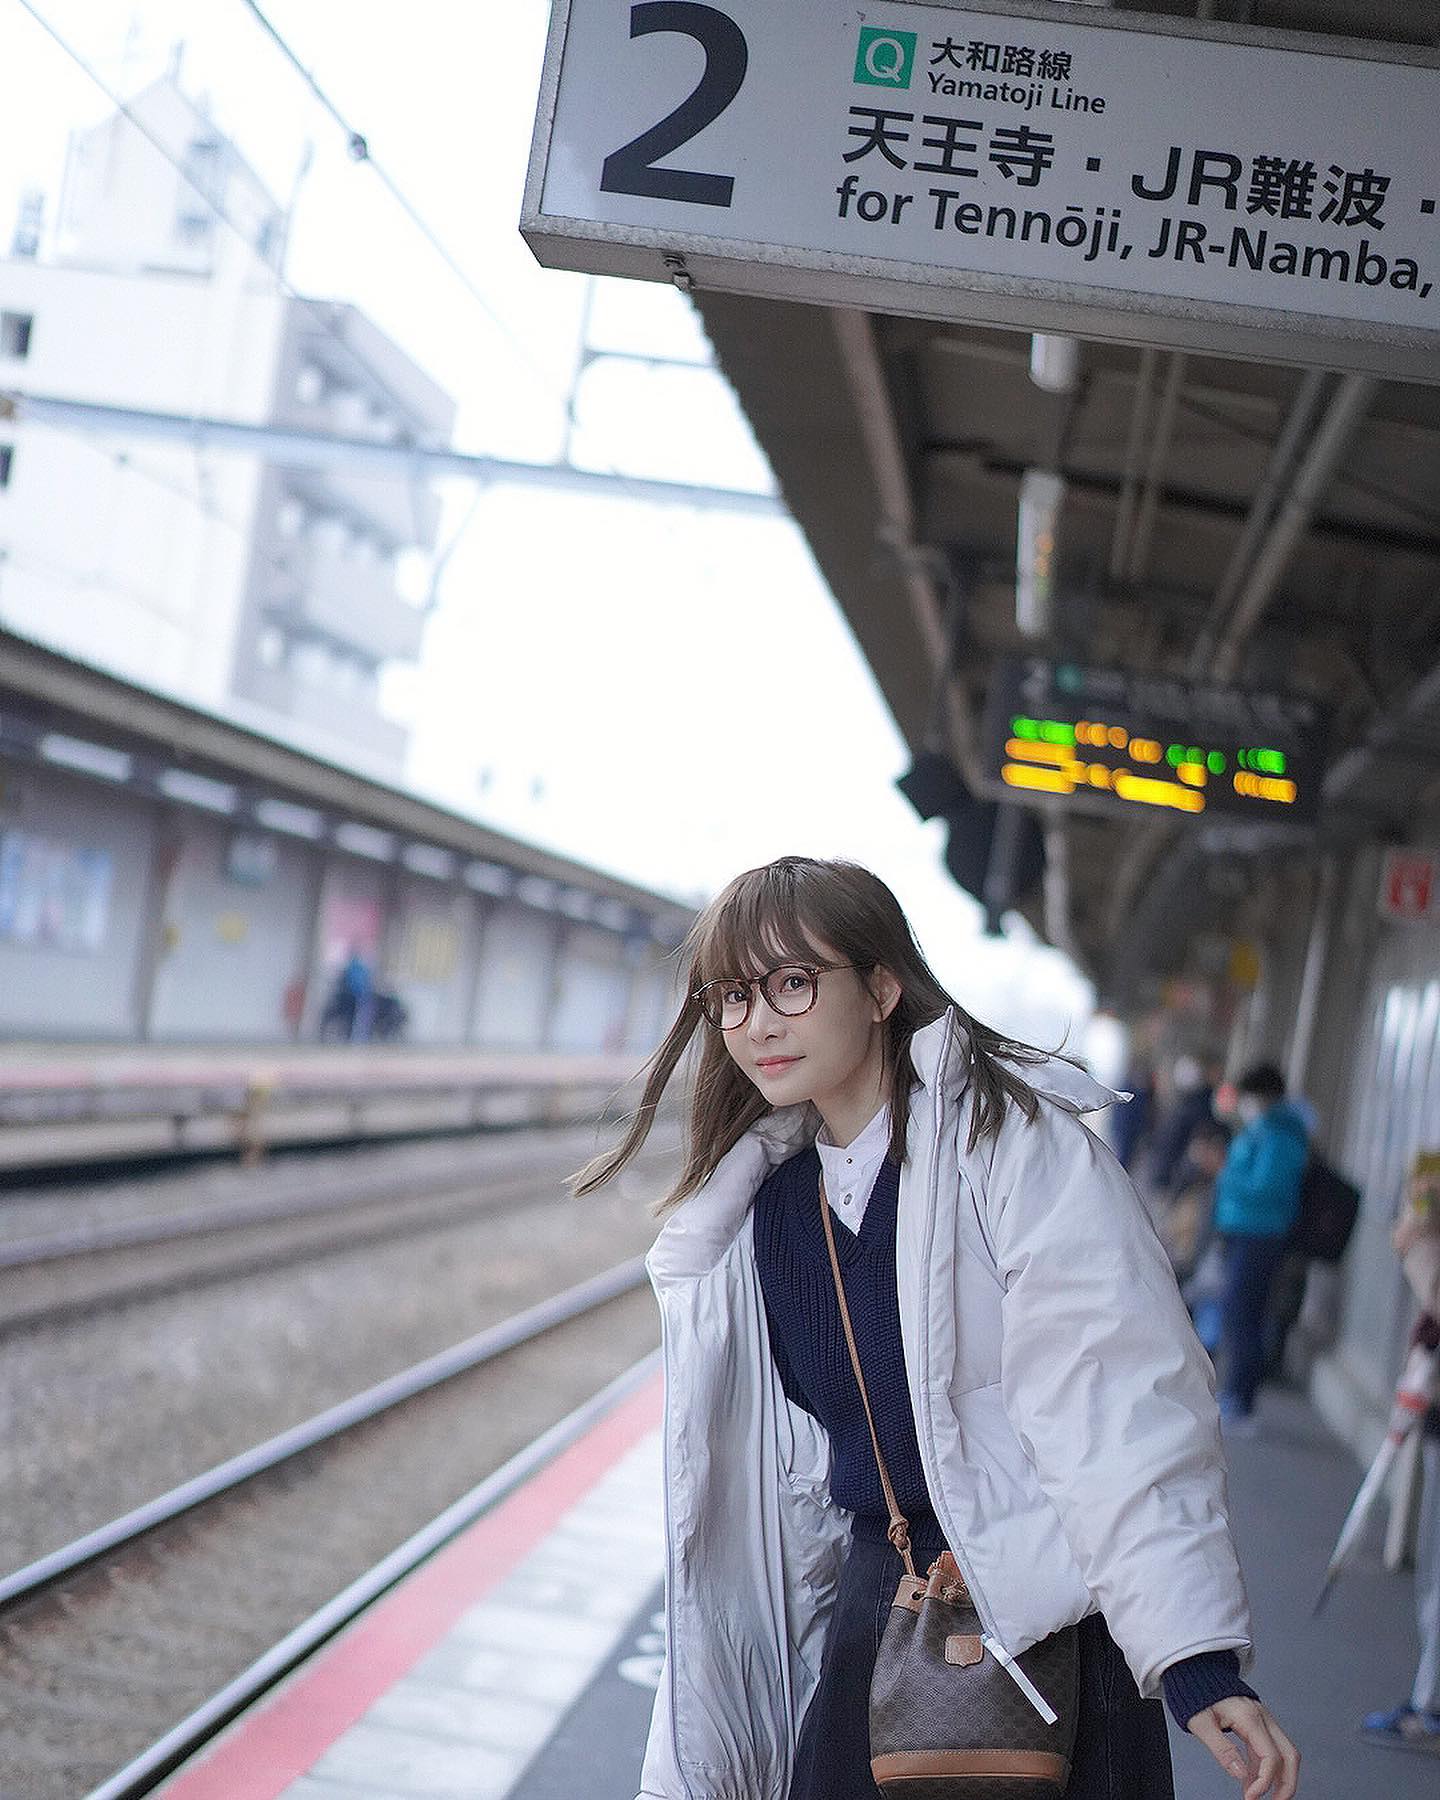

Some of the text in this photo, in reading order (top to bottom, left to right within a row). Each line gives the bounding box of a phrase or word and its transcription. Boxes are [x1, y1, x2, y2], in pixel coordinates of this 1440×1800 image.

[866, 37, 905, 82] Q
[929, 36, 1072, 81] 大和路線
[599, 0, 748, 208] 2
[928, 71, 1107, 115] Yamatoji Line
[836, 176, 1434, 298] for Tennōji, JR-Namba,
